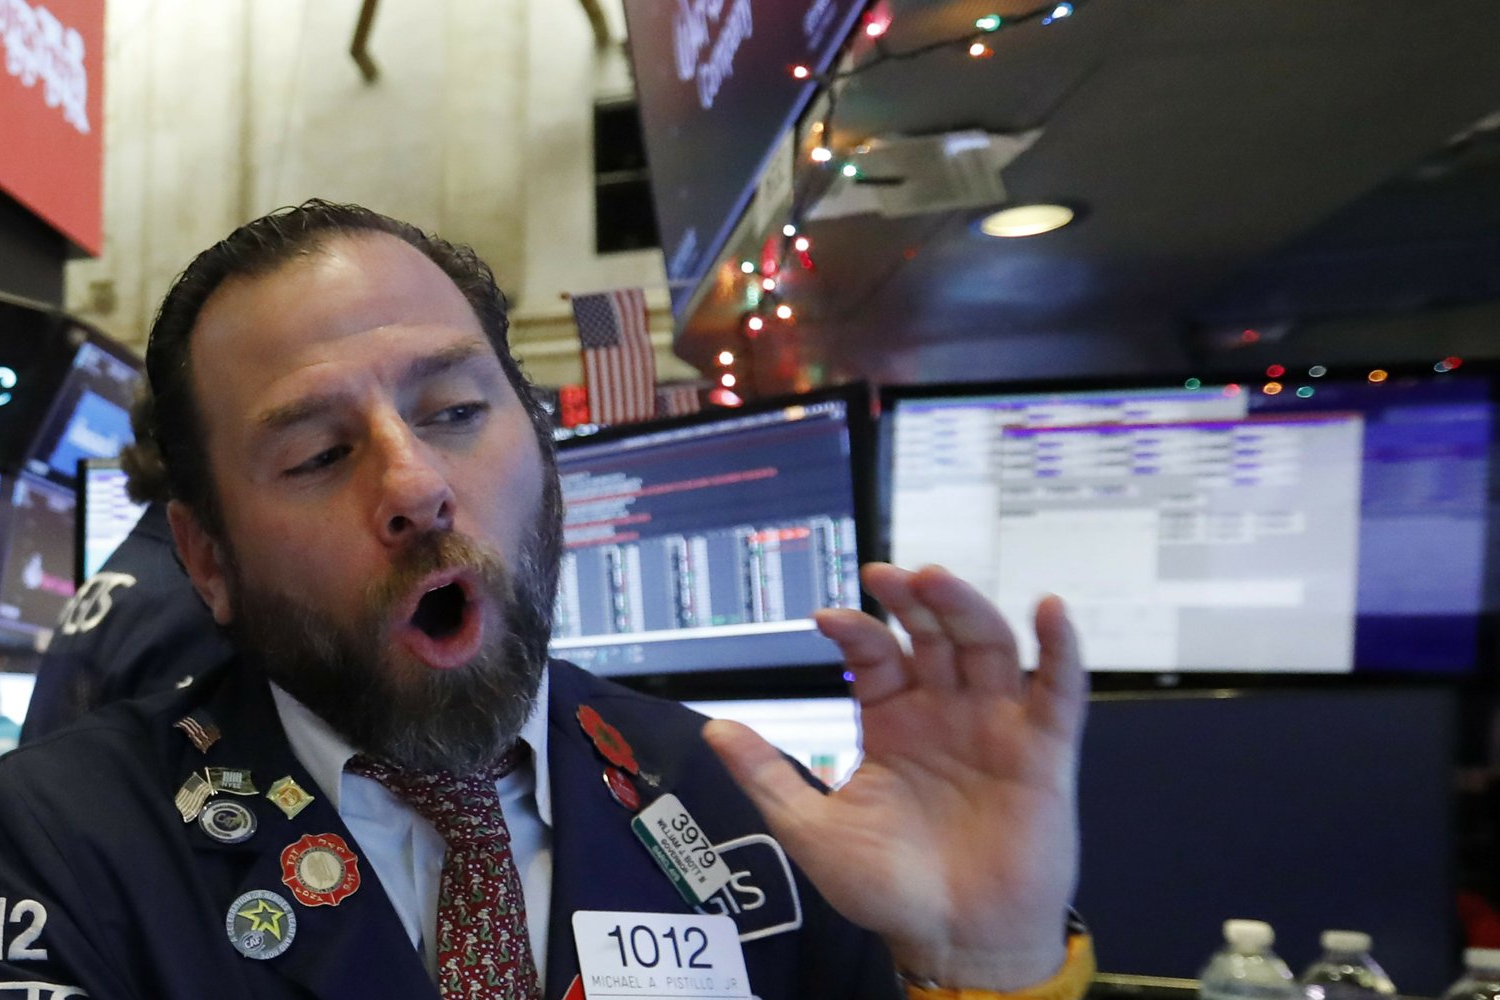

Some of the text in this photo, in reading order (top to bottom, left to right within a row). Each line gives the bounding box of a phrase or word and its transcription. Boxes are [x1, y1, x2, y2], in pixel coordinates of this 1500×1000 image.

[657, 819, 682, 848] WILLIAM
[684, 855, 703, 876] BOTT
[660, 838, 689, 874] GOVERNOR
[671, 813, 716, 869] 3979
[295, 887, 323, 902] FDNY
[244, 937, 260, 949] CAF
[607, 924, 713, 969] 1012
[591, 975, 643, 989] MICHAEL
[666, 977, 715, 990] PISTILLO
